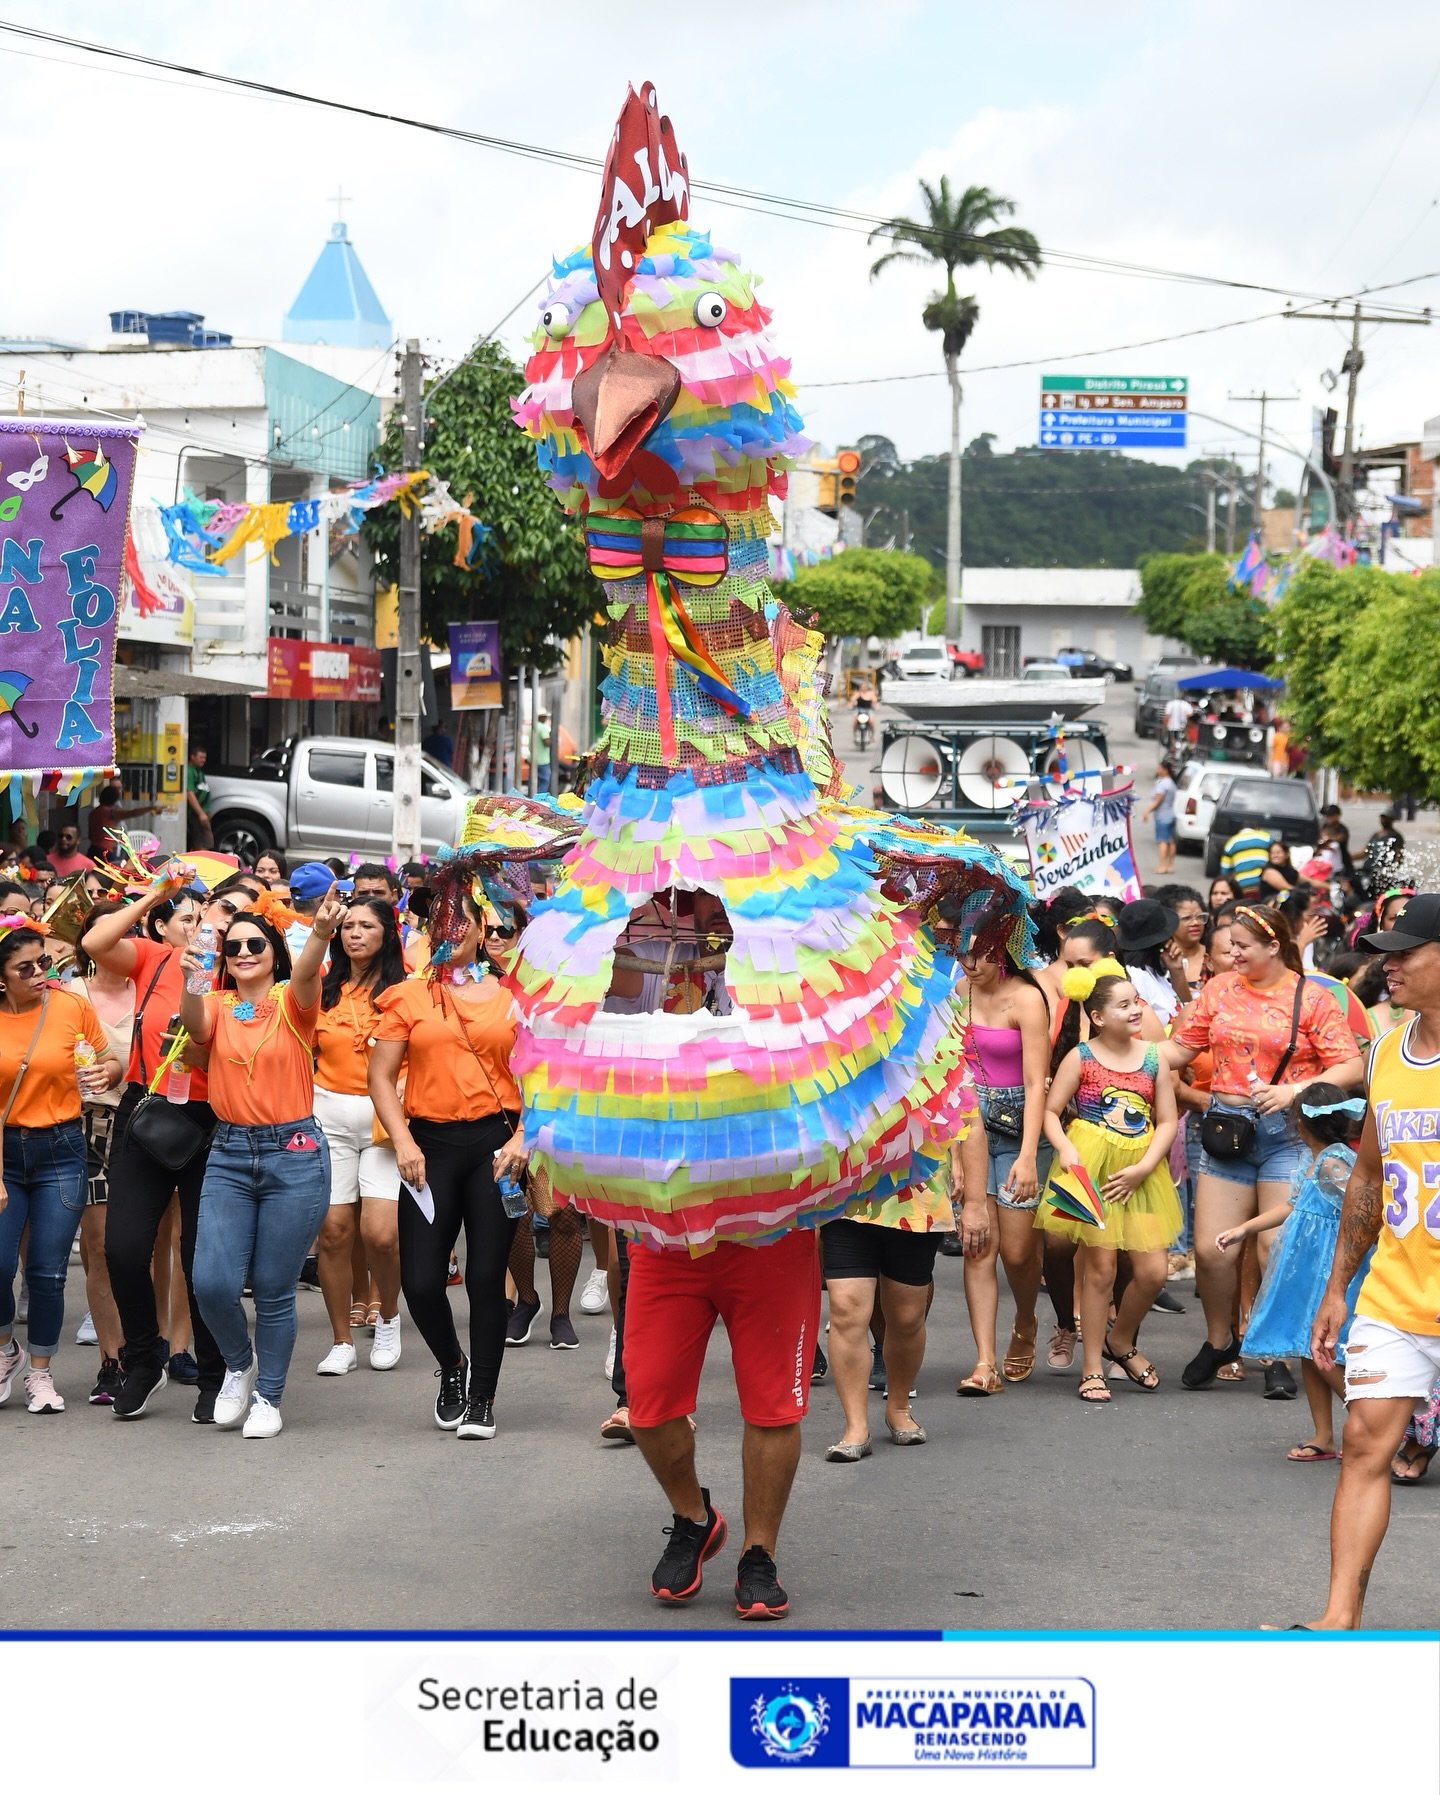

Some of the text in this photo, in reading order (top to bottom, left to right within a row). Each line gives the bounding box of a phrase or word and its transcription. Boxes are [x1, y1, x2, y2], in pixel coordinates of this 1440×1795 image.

[1085, 379, 1127, 390] Distrito
[1139, 396, 1183, 410] Amparo
[1059, 414, 1171, 429] Prefeitura Municipal
[1077, 433, 1093, 444] PE
[56, 544, 115, 750] FOLIA
[1034, 833, 1128, 892] Terezinha
